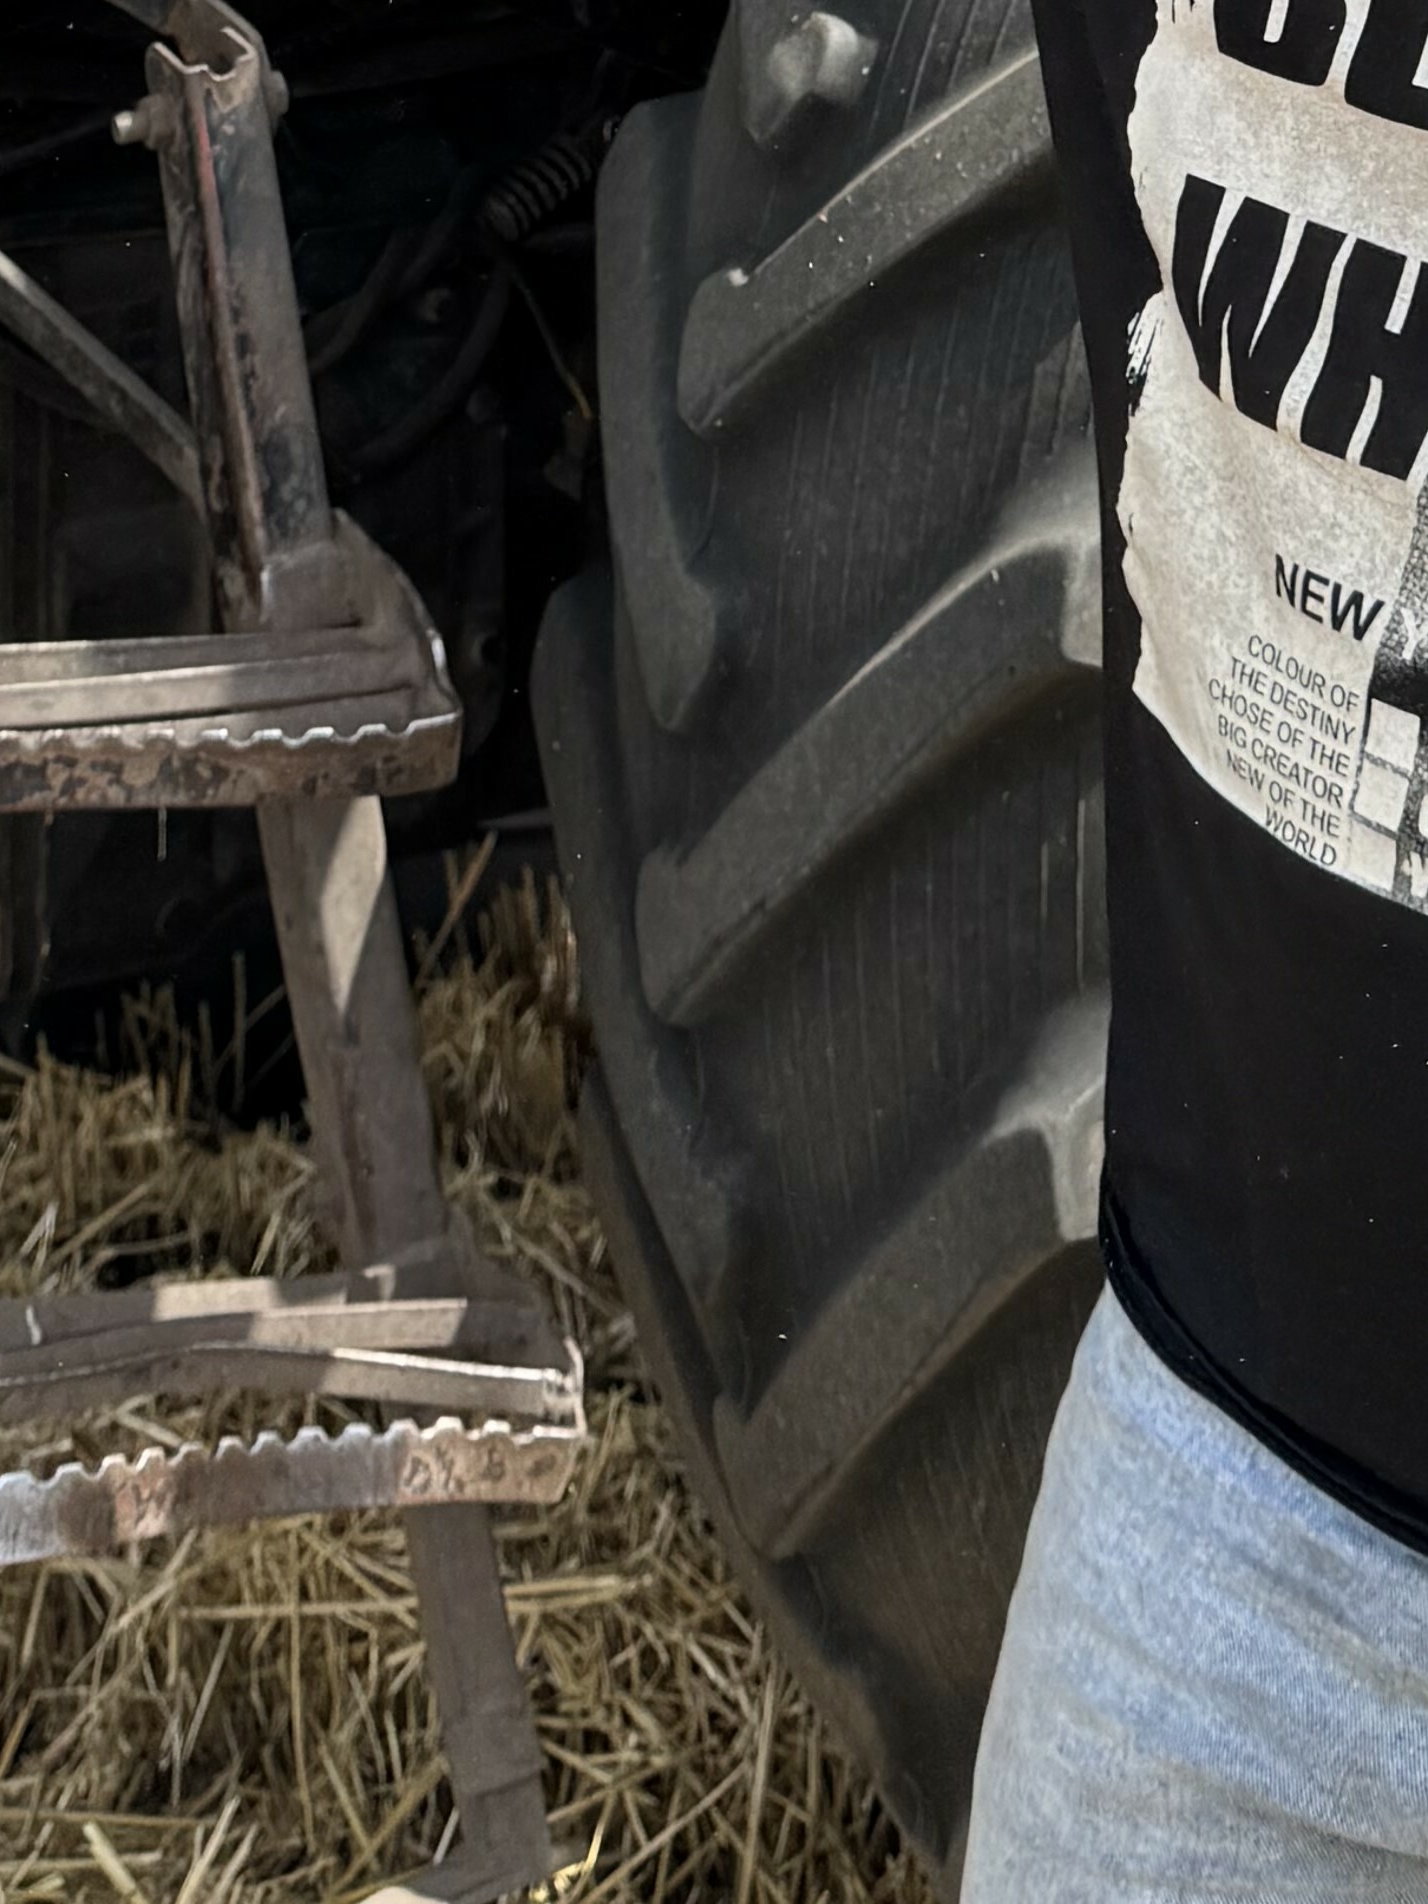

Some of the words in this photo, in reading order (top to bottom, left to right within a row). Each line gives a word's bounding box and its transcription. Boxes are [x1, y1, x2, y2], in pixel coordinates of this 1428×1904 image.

[1274, 553, 1385, 642] NEW
[1230, 655, 1269, 697] THE
[1269, 681, 1357, 746] DESTINY
[1247, 634, 1327, 699] COLOUR
[1330, 684, 1360, 713] OF
[1208, 678, 1274, 735] CHOSE
[1276, 720, 1305, 749] OF
[1310, 737, 1351, 778] THE
[1217, 713, 1248, 749] BIG
[1251, 738, 1344, 809] CREATOR
[1226, 749, 1266, 791] NEW
[1269, 780, 1296, 809] OF
[1300, 797, 1341, 839] THE
[1265, 804, 1338, 868] WORLD
